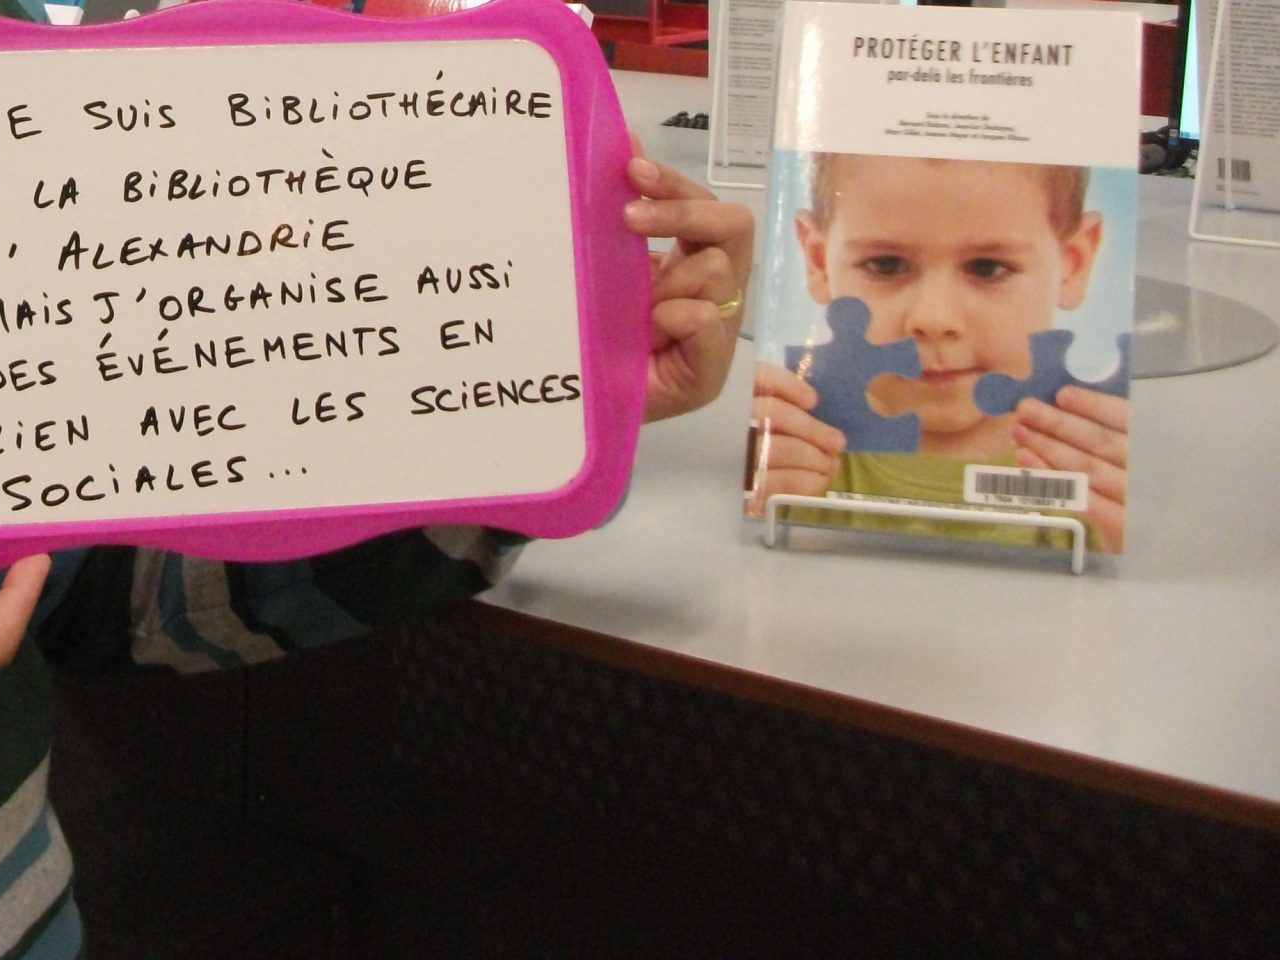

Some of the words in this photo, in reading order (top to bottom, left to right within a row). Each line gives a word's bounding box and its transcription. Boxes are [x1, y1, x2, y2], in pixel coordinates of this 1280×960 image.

[853, 34, 961, 62] PROTÉGER
[972, 42, 1074, 66] L'ENFANT
[946, 68, 964, 84] les
[83, 99, 176, 131] SUIS
[34, 177, 79, 209] LA
[417, 260, 512, 294] AUSSI
[96, 326, 400, 381] ÉVÉNEMENTS
[440, 319, 493, 350] EN
[140, 405, 246, 437] AVEC
[292, 392, 366, 425] LES
